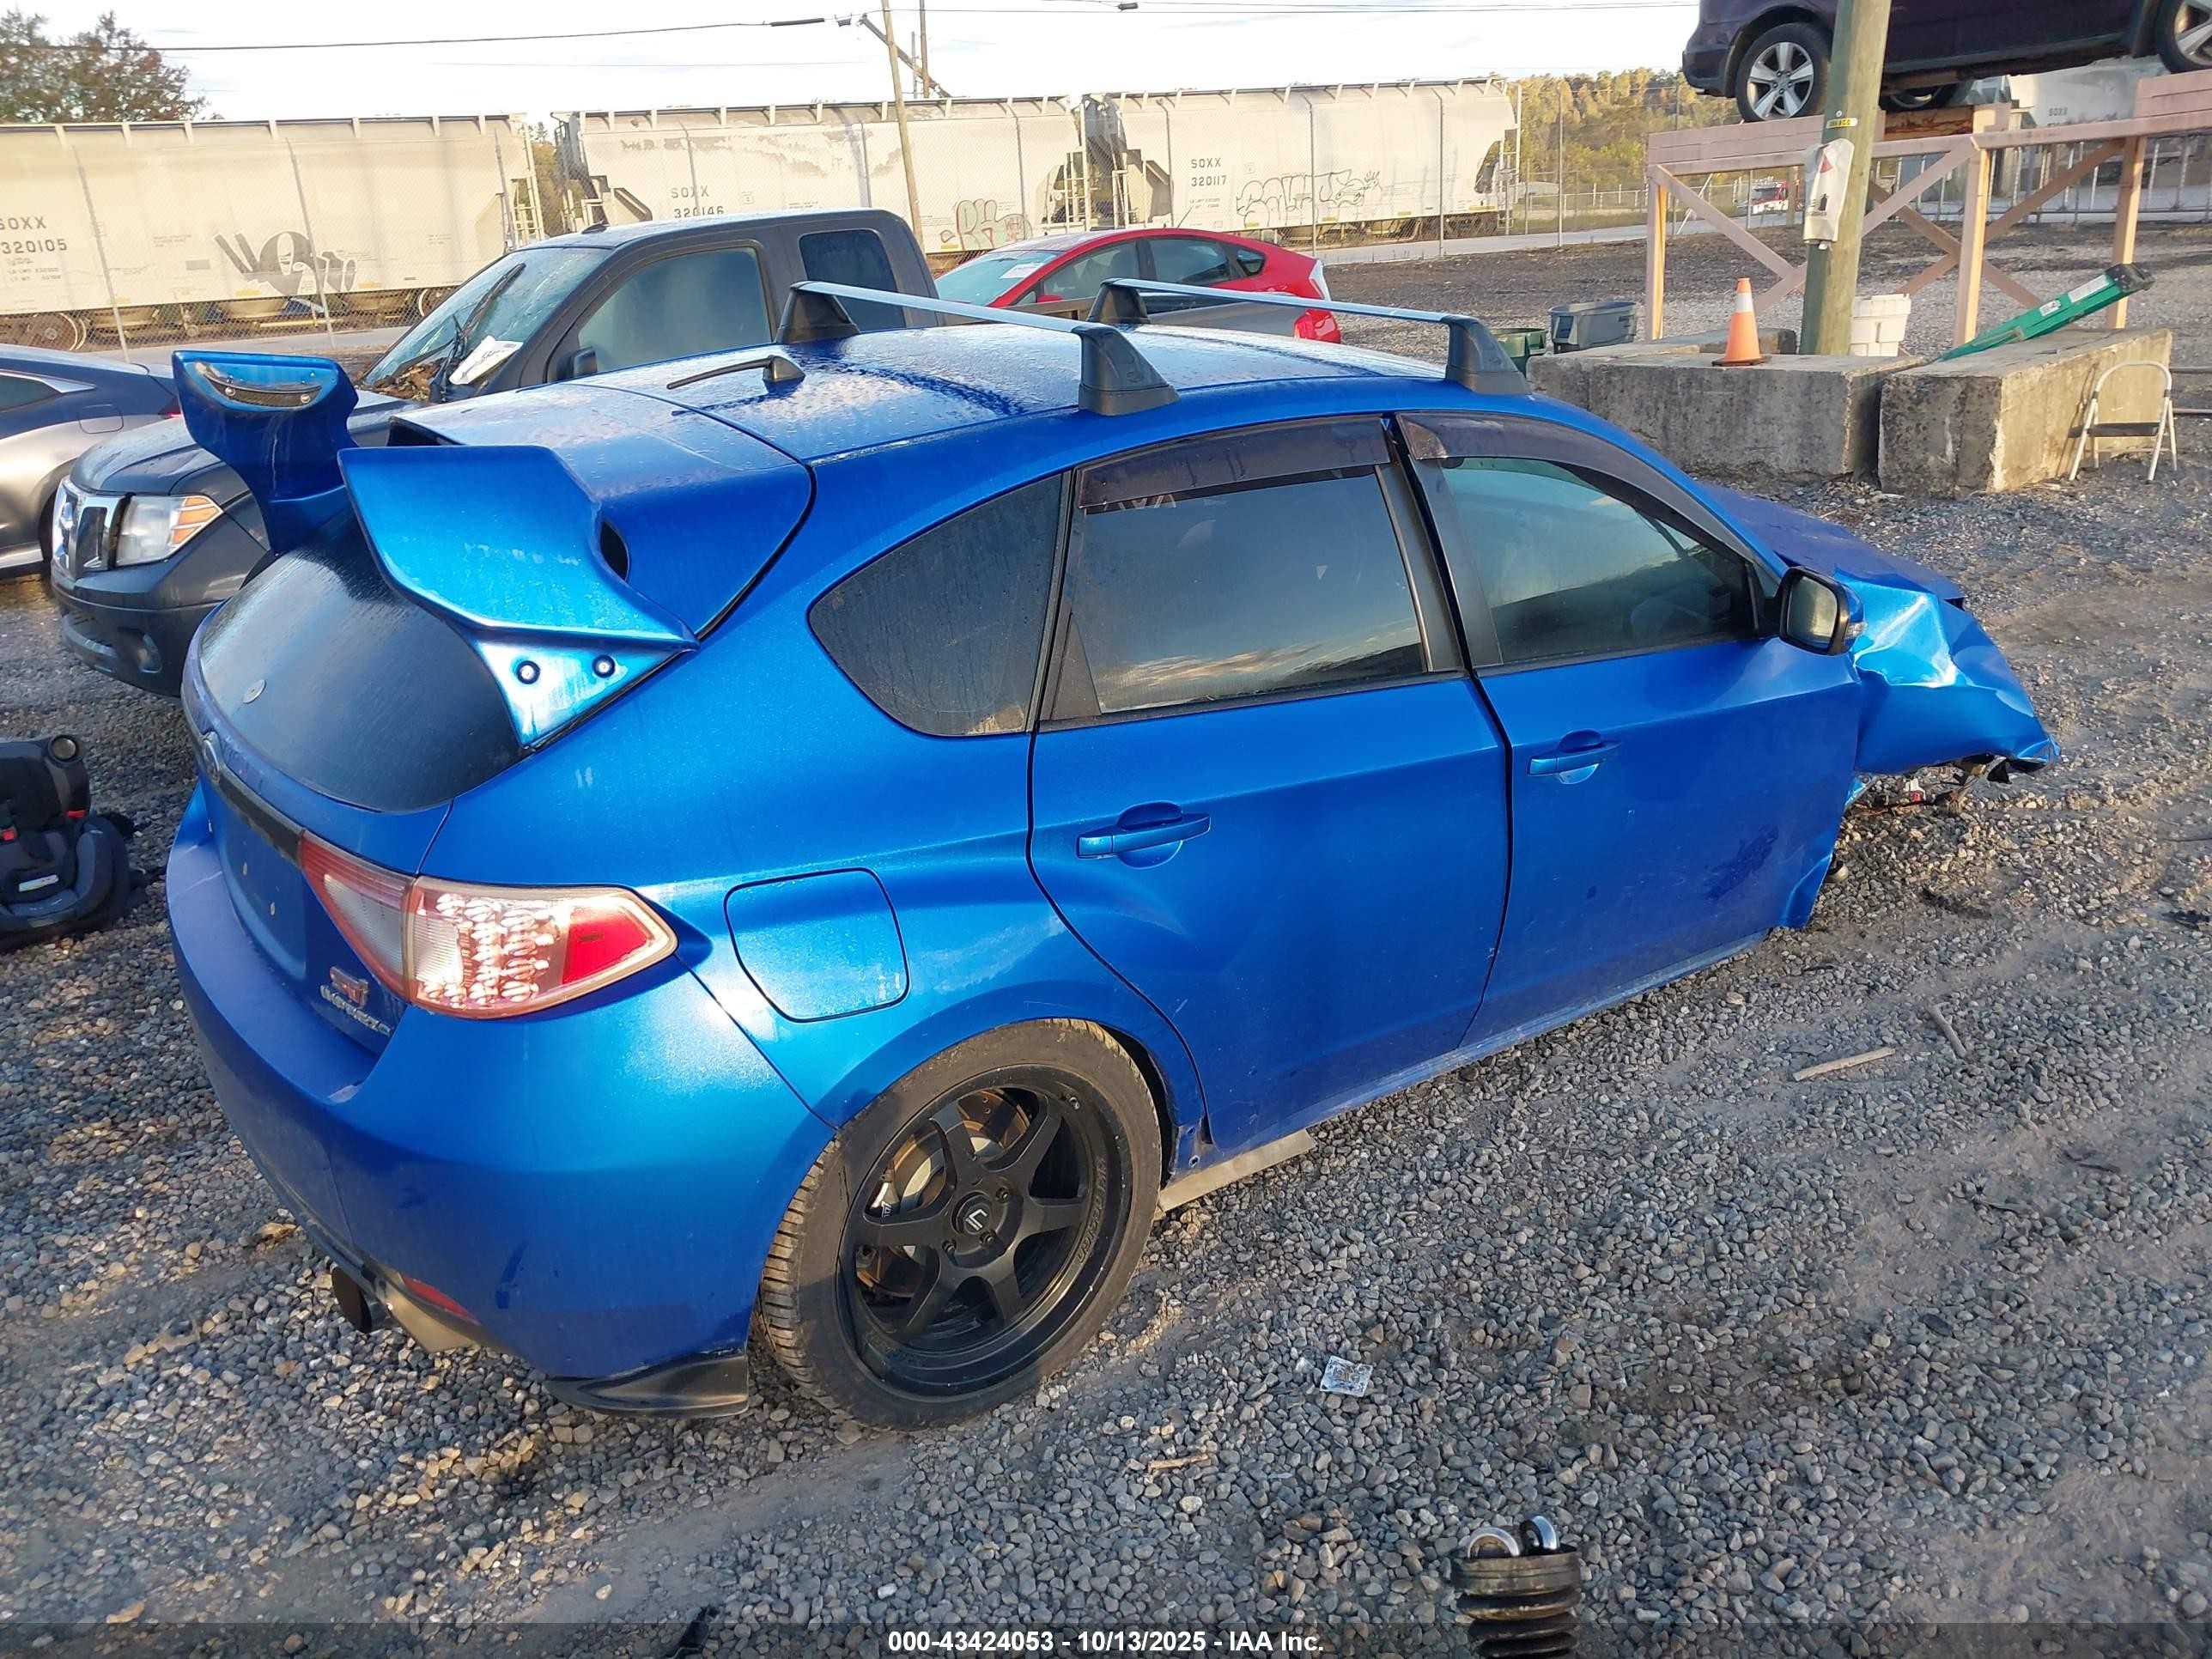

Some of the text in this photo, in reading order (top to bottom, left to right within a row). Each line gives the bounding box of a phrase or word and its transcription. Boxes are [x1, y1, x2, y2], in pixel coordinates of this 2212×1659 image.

[1191, 158, 1220, 168] SOXX
[1191, 174, 1227, 187] 320117
[672, 185, 710, 198] SOXX
[1, 239, 67, 254] 320105
